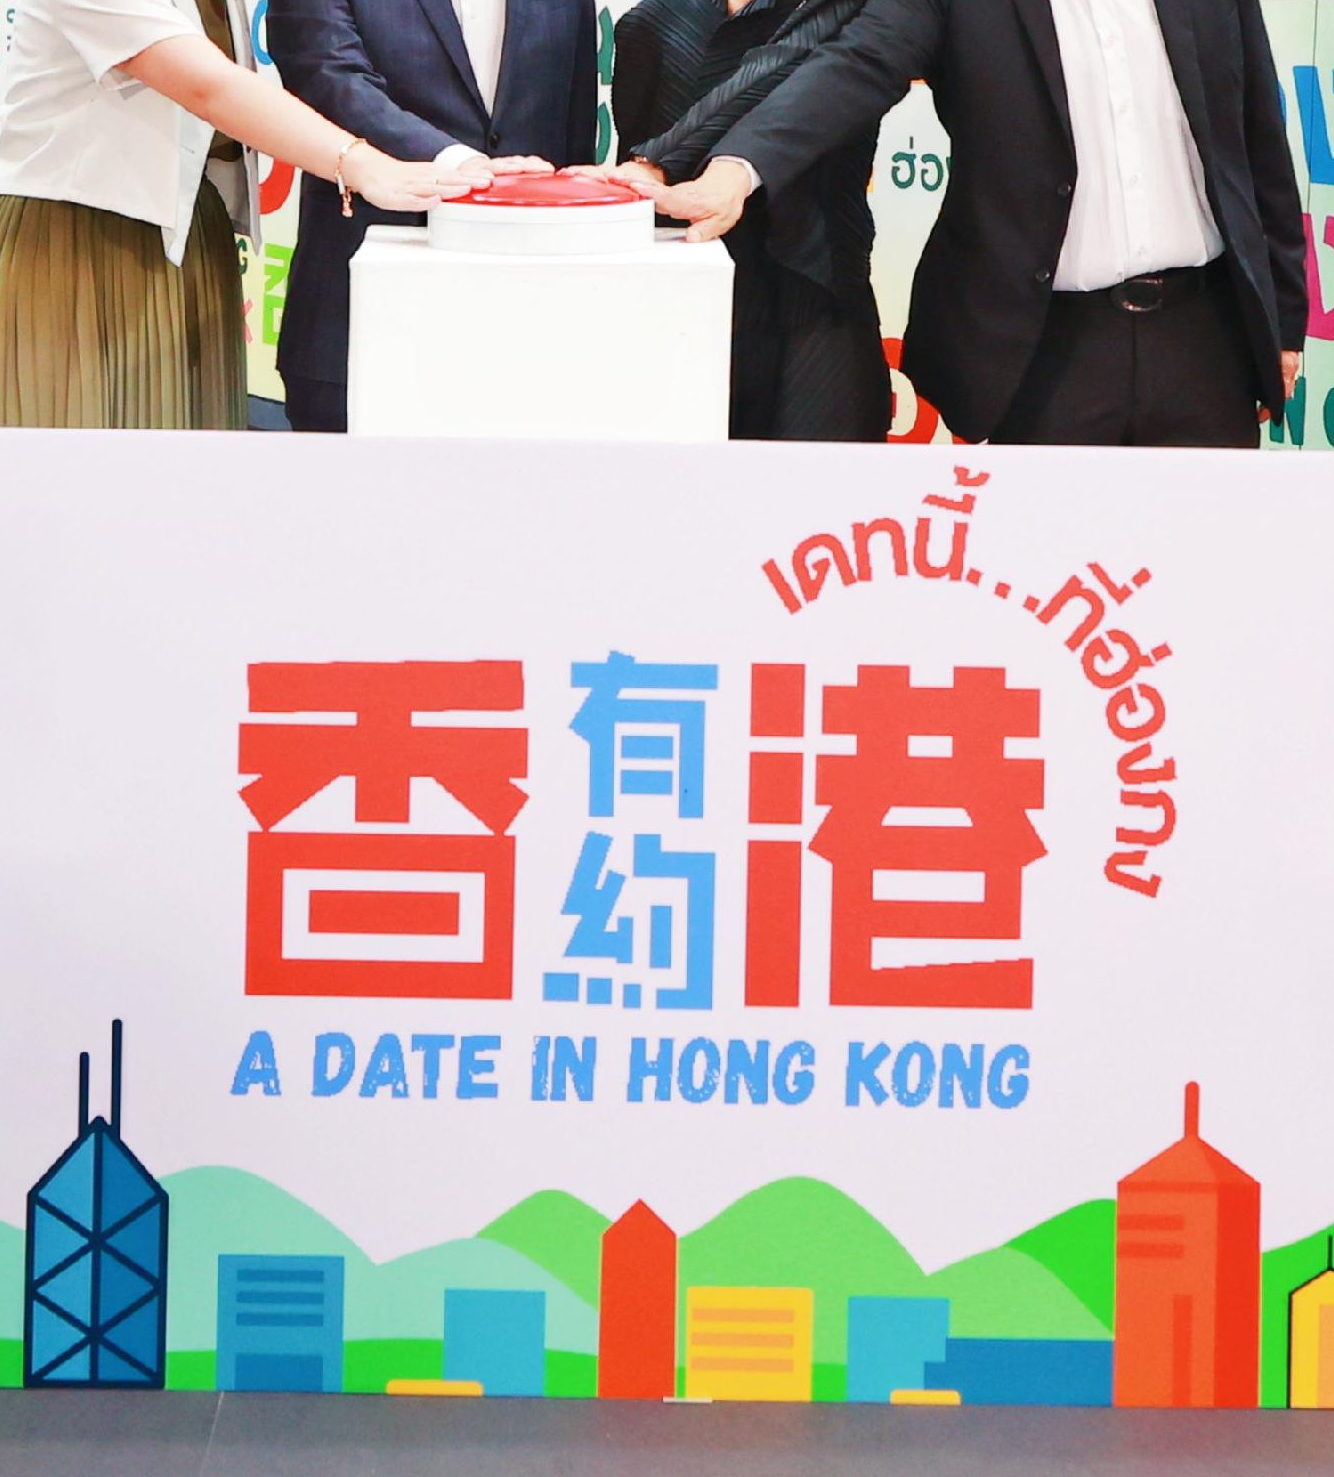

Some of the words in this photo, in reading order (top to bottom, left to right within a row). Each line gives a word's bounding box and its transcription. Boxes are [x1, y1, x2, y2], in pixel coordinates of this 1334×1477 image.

[892, 136, 951, 192] ฮ่อ
[230, 1030, 282, 1097] A
[311, 1033, 502, 1100] DATE
[530, 1035, 598, 1102] IN
[626, 1036, 816, 1105] HONG
[845, 1041, 1031, 1109] KONG
